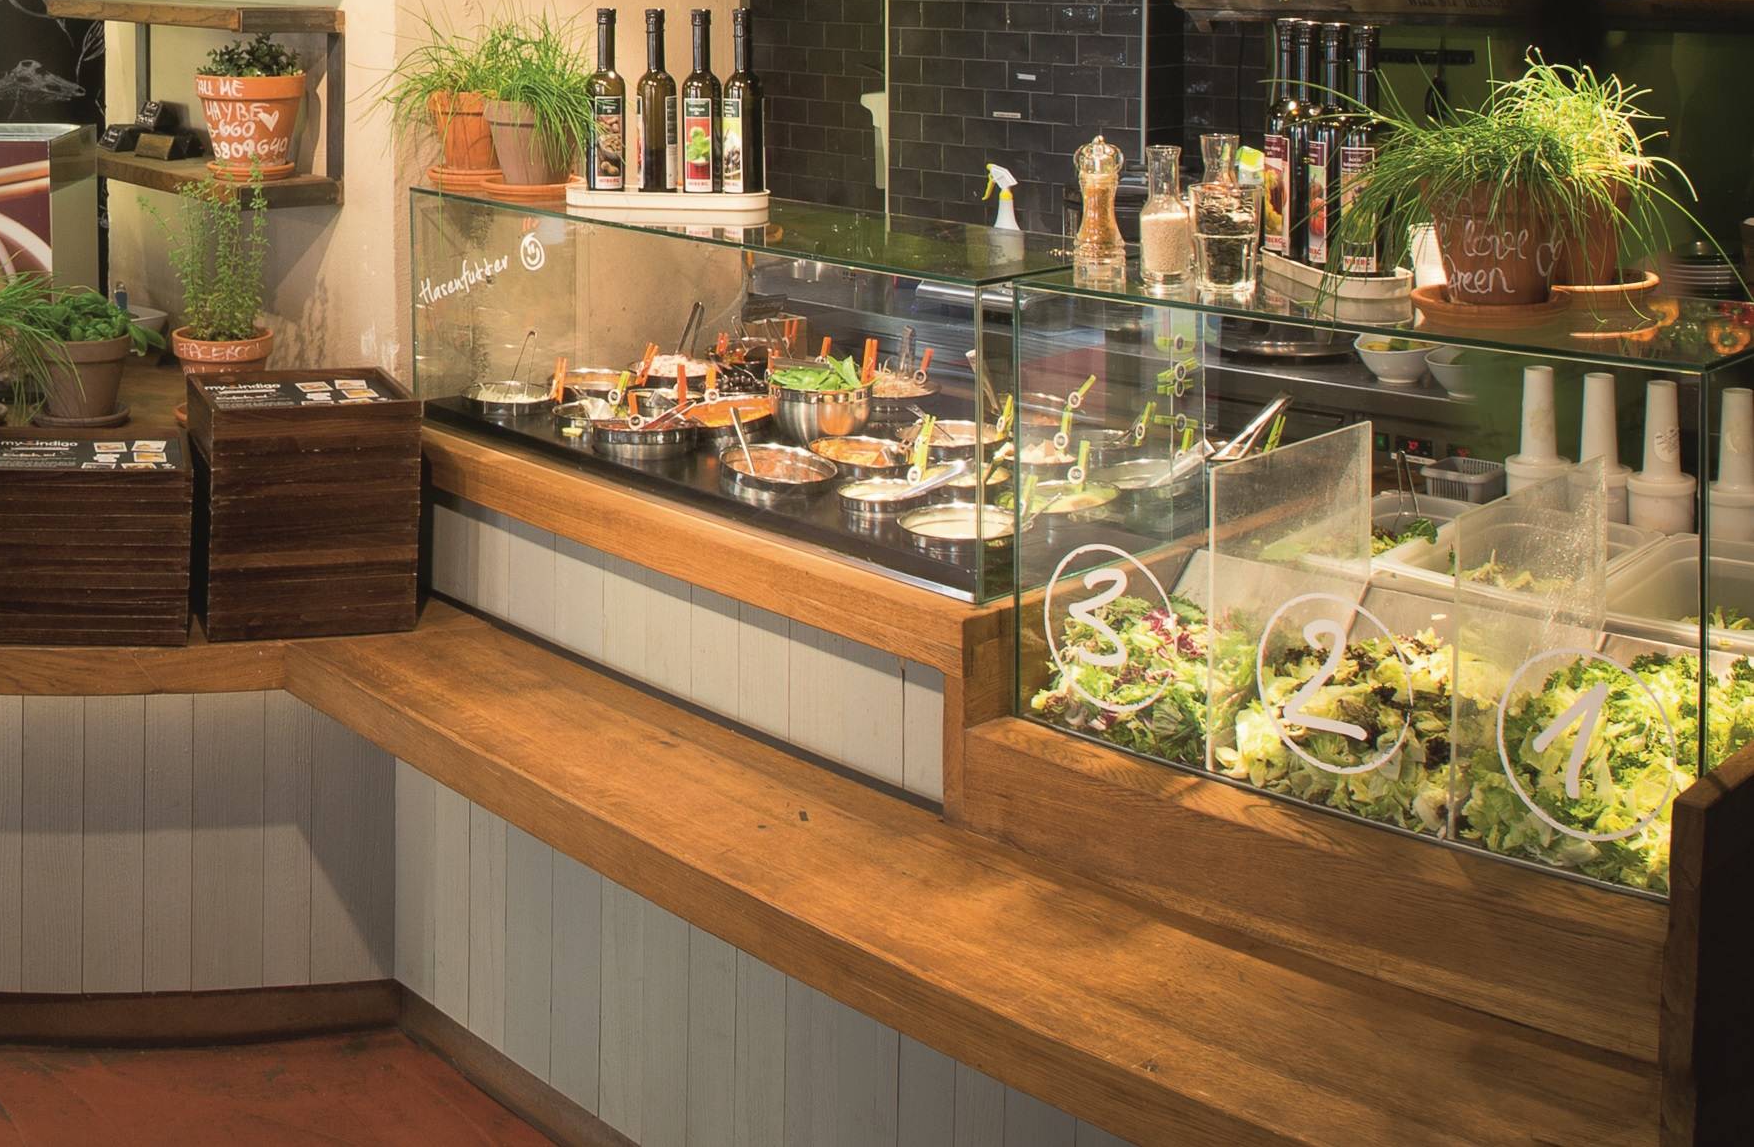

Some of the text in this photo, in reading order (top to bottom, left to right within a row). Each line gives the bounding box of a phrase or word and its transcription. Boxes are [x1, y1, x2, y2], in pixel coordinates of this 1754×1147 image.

[418, 254, 508, 304] Hasenfutter
[1463, 220, 1529, 260] love
[1068, 568, 1129, 668] 3
[1281, 618, 1368, 741] 2
[1533, 681, 1608, 800] 1
